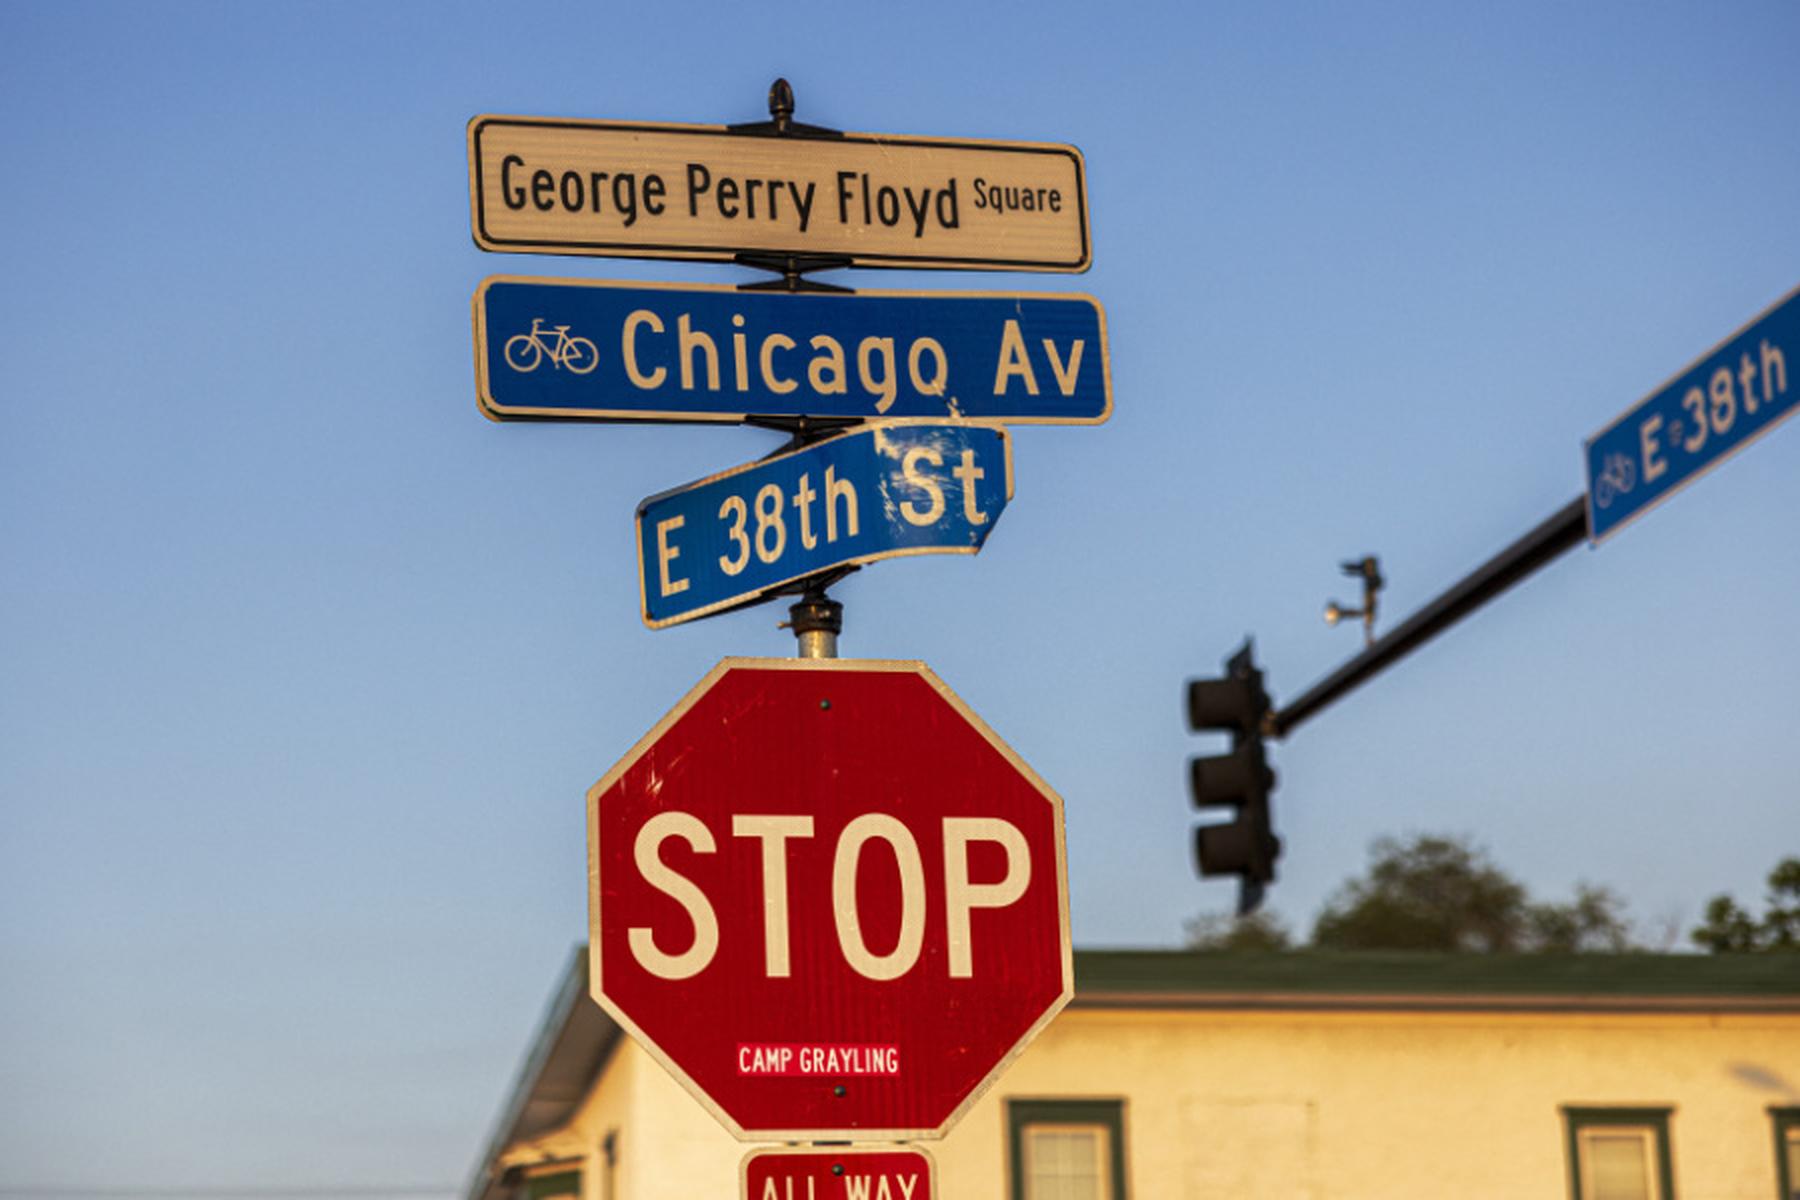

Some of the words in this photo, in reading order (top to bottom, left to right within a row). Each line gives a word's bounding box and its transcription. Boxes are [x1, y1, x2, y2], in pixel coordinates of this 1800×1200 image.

[501, 154, 667, 228] George
[686, 163, 817, 233] Perry
[836, 171, 960, 238] Floyd
[973, 177, 1063, 214] Square
[621, 309, 950, 415] Chicago
[993, 319, 1086, 396] Av
[1639, 413, 1668, 485] E
[1682, 338, 1788, 454] 38th
[656, 514, 690, 597] E
[717, 464, 859, 577] 38th
[899, 447, 989, 527] St
[627, 811, 1032, 981] STOP
[738, 1046, 793, 1073] CAMP
[800, 1047, 898, 1073] GRAYLING
